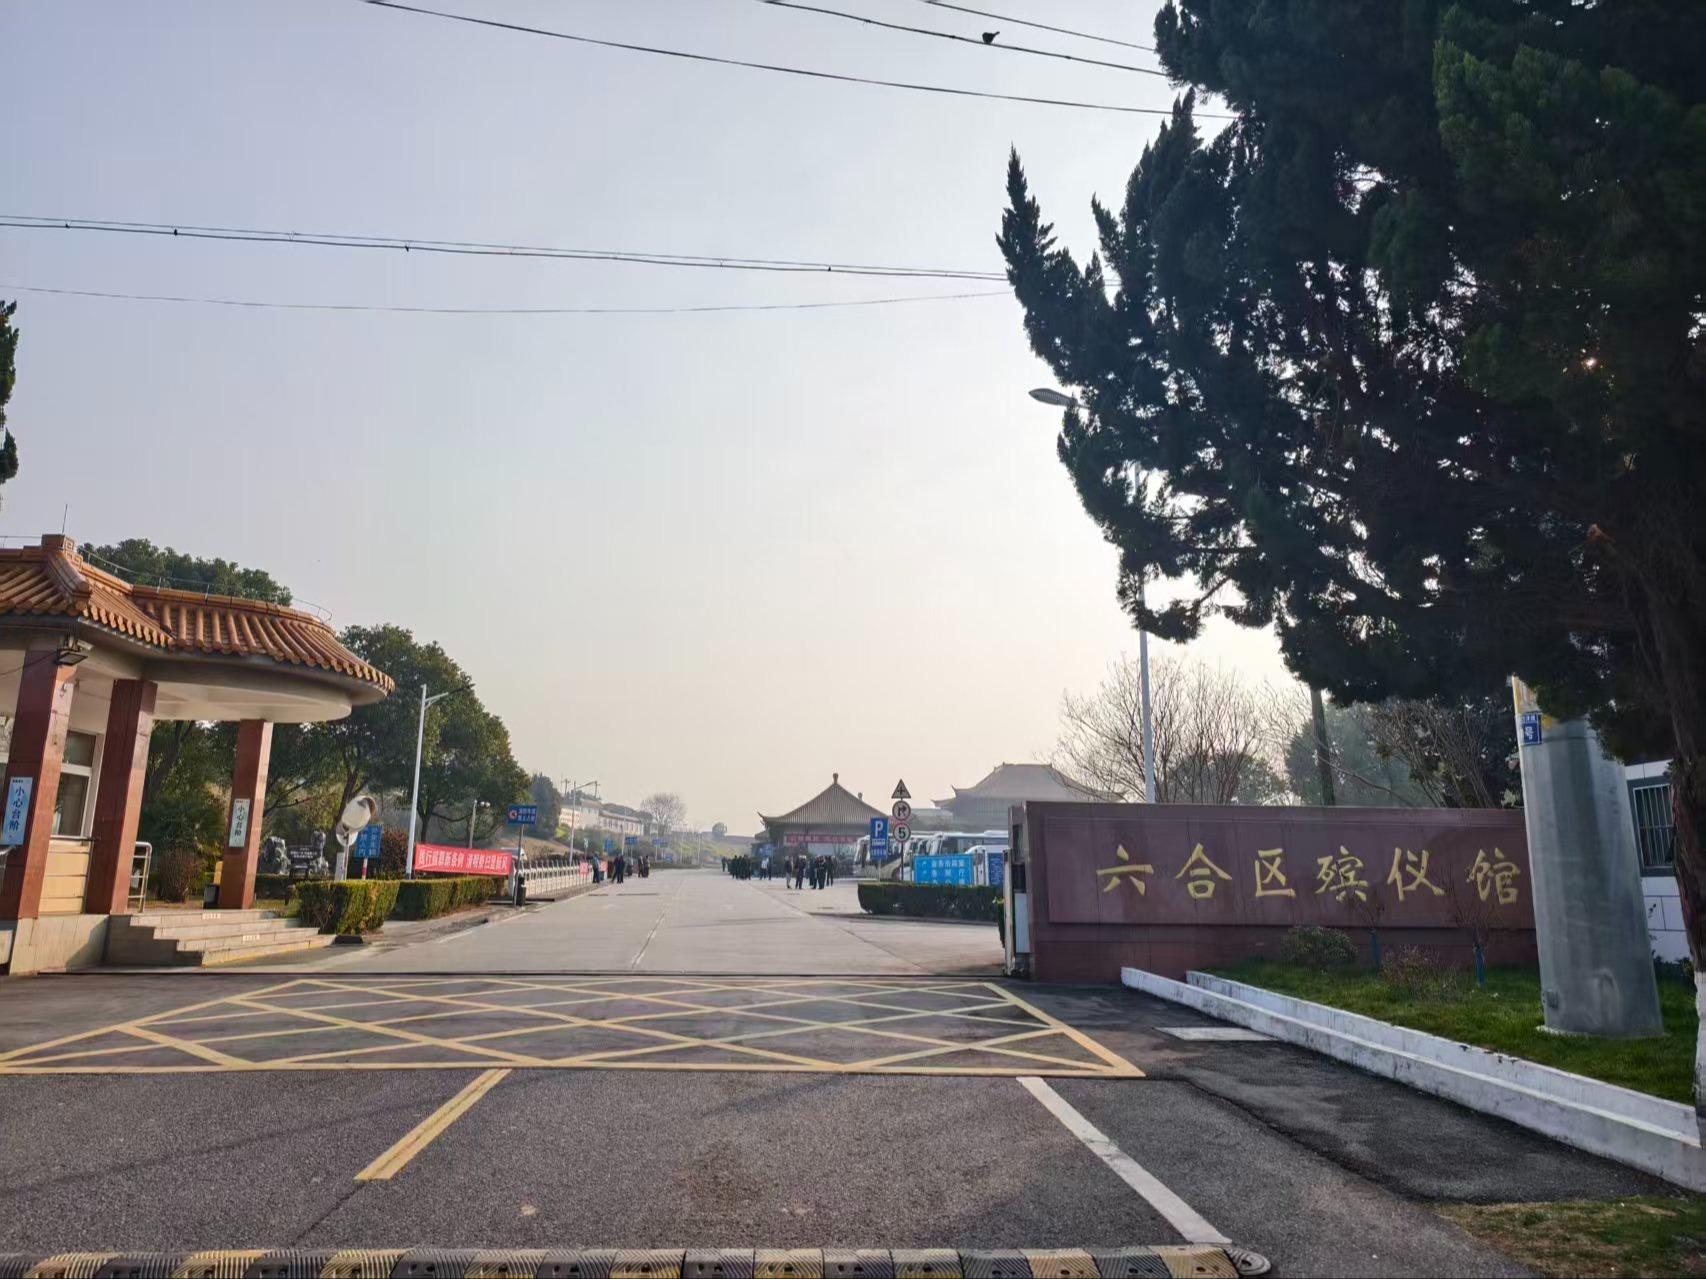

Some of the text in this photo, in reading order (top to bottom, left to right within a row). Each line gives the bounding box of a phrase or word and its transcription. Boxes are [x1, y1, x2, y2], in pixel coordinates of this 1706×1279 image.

[9, 786, 25, 832] 小心台阶
[235, 804, 245, 837] 小心台阶
[875, 820, 884, 838] P
[898, 827, 906, 839] 5
[1096, 843, 1521, 905] 六合区殡仪馆
